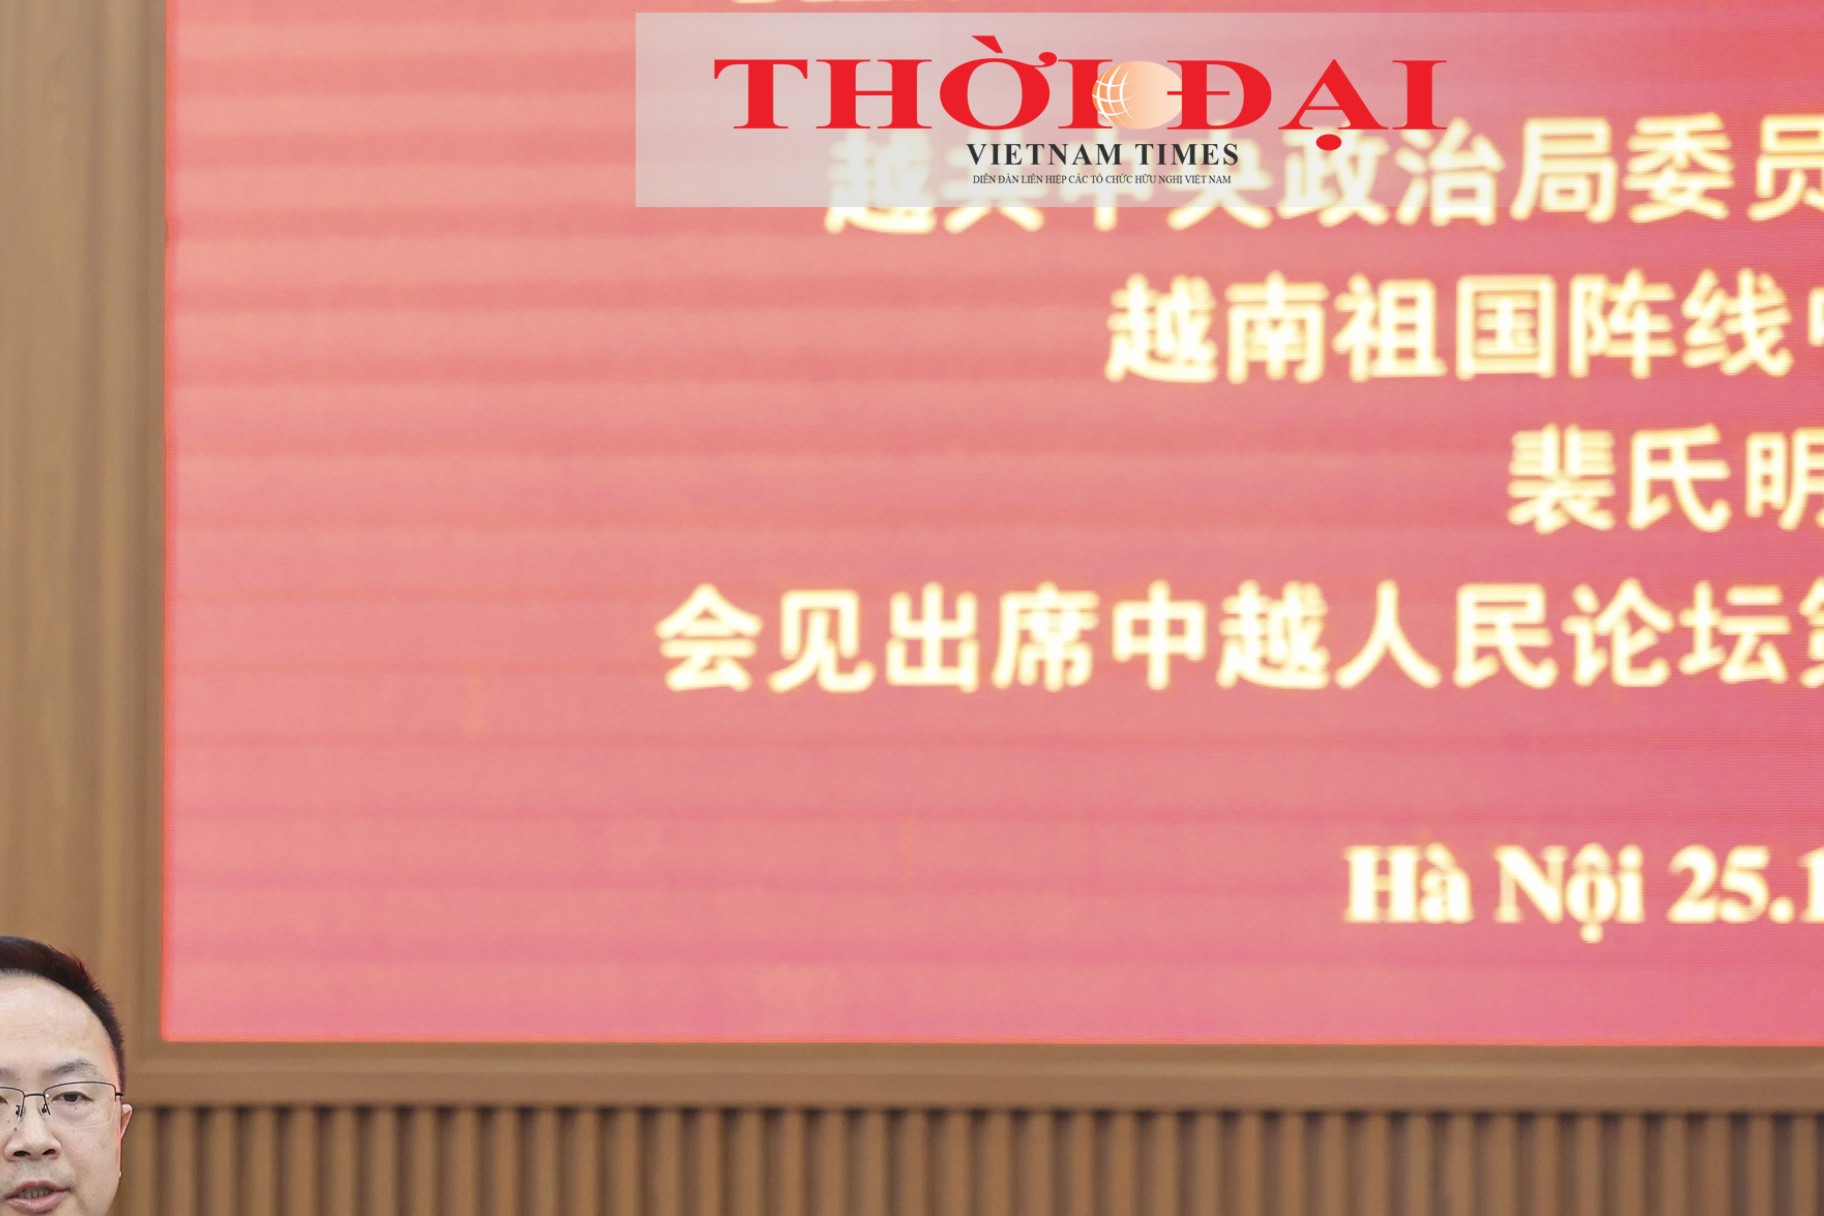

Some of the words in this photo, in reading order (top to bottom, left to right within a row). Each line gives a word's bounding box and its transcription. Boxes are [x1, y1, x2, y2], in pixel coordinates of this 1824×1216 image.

[1104, 268, 1824, 384] 越南祖国阵线
[654, 577, 1824, 693] 会见出席中越人民论坛
[1344, 842, 1472, 924] Hà
[1494, 841, 1644, 944] Nội
